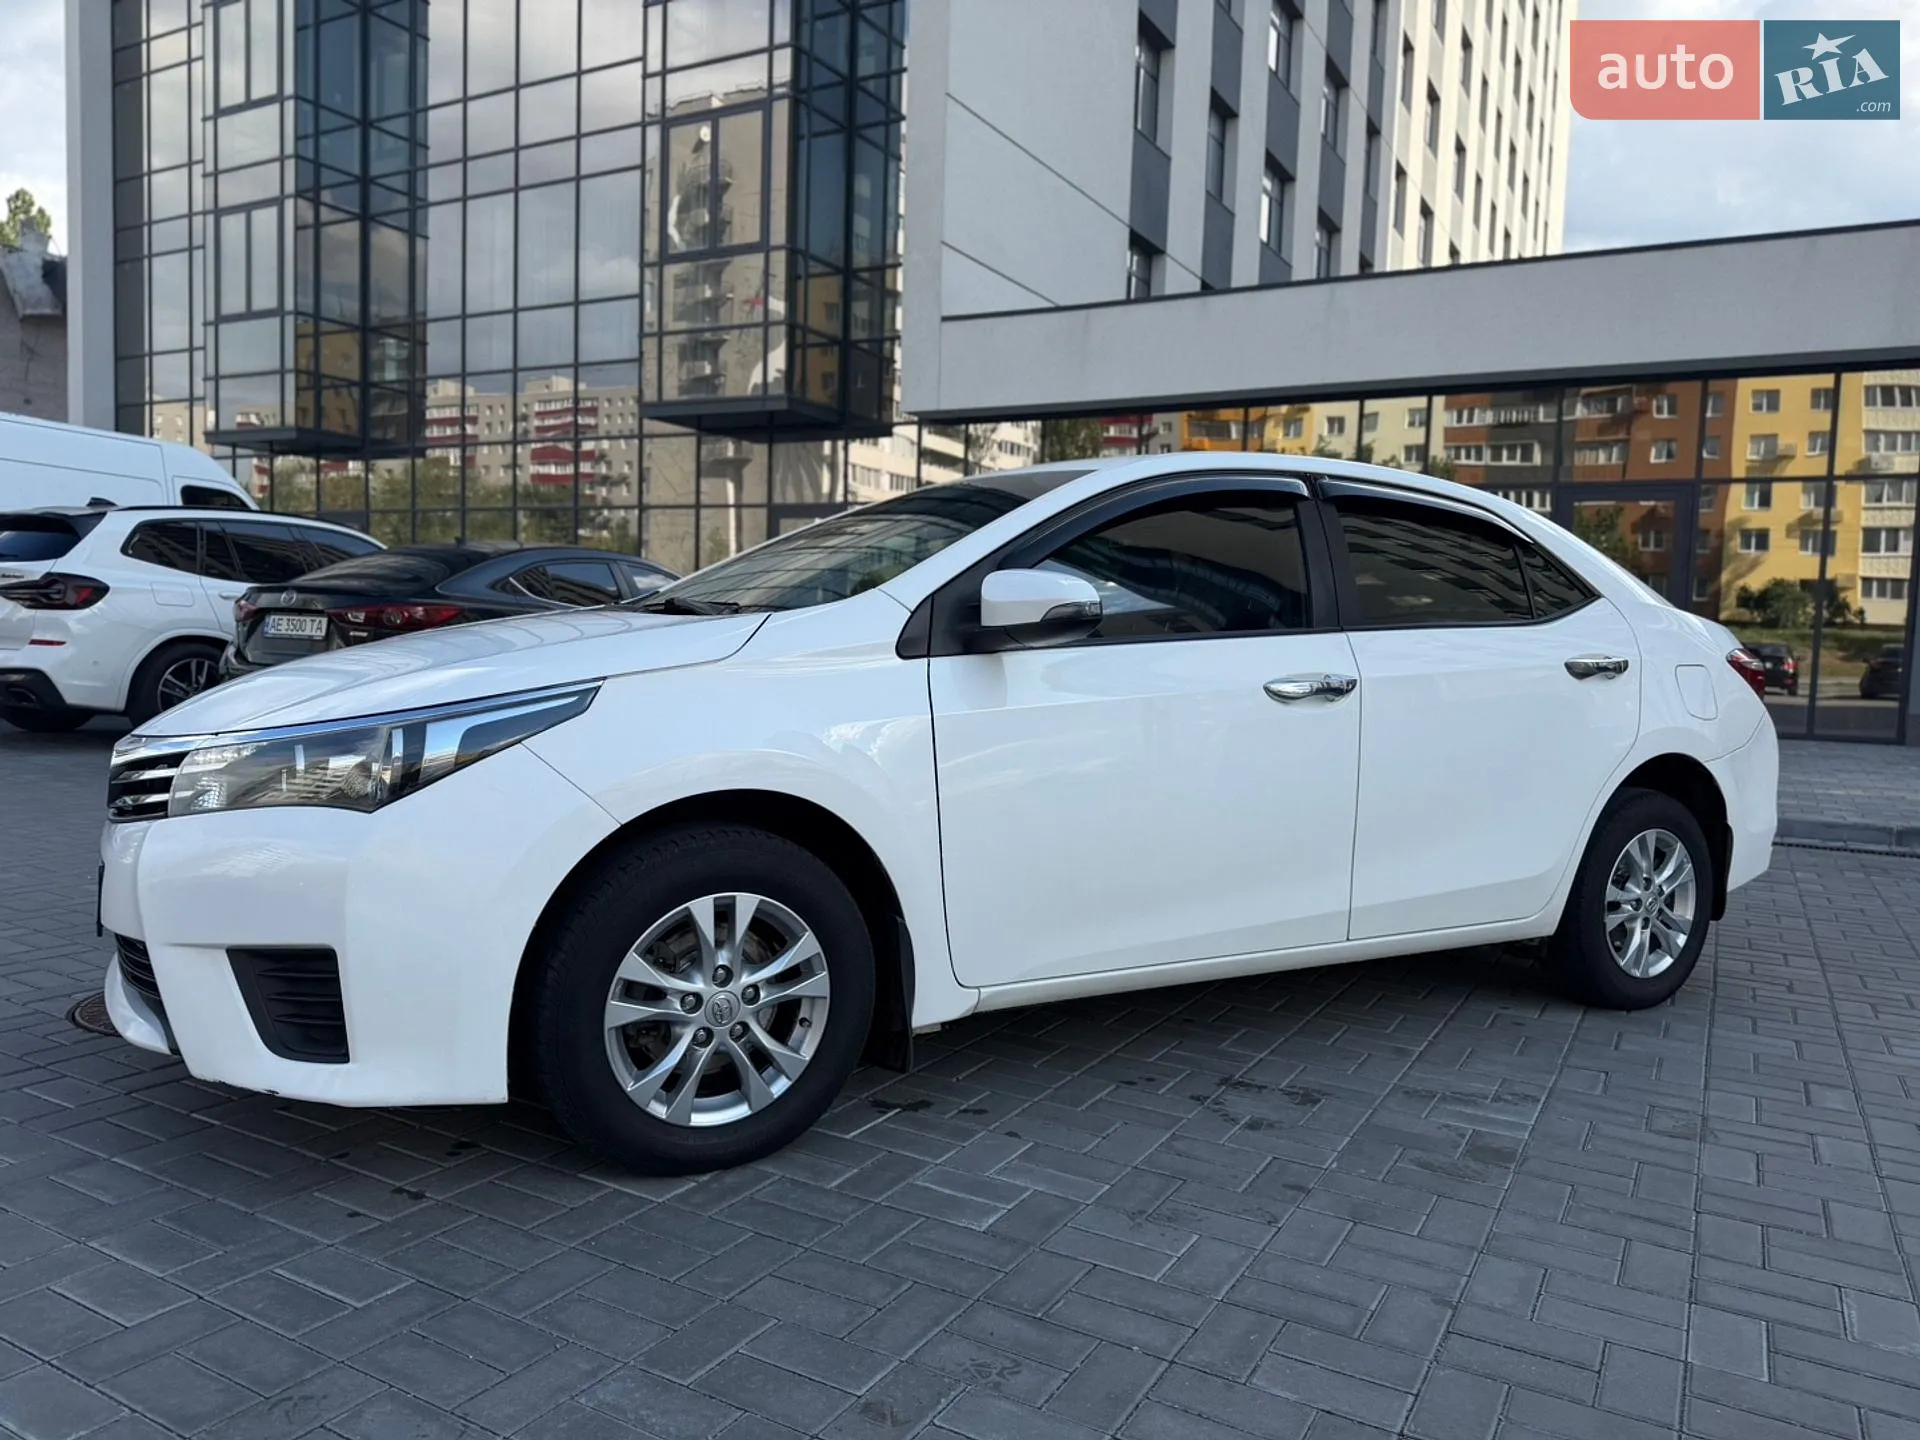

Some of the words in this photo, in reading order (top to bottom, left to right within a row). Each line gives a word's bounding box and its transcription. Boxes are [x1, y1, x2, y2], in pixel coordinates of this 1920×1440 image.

[269, 617, 283, 632] AE
[285, 618, 307, 633] 3500
[310, 618, 323, 633] TA
